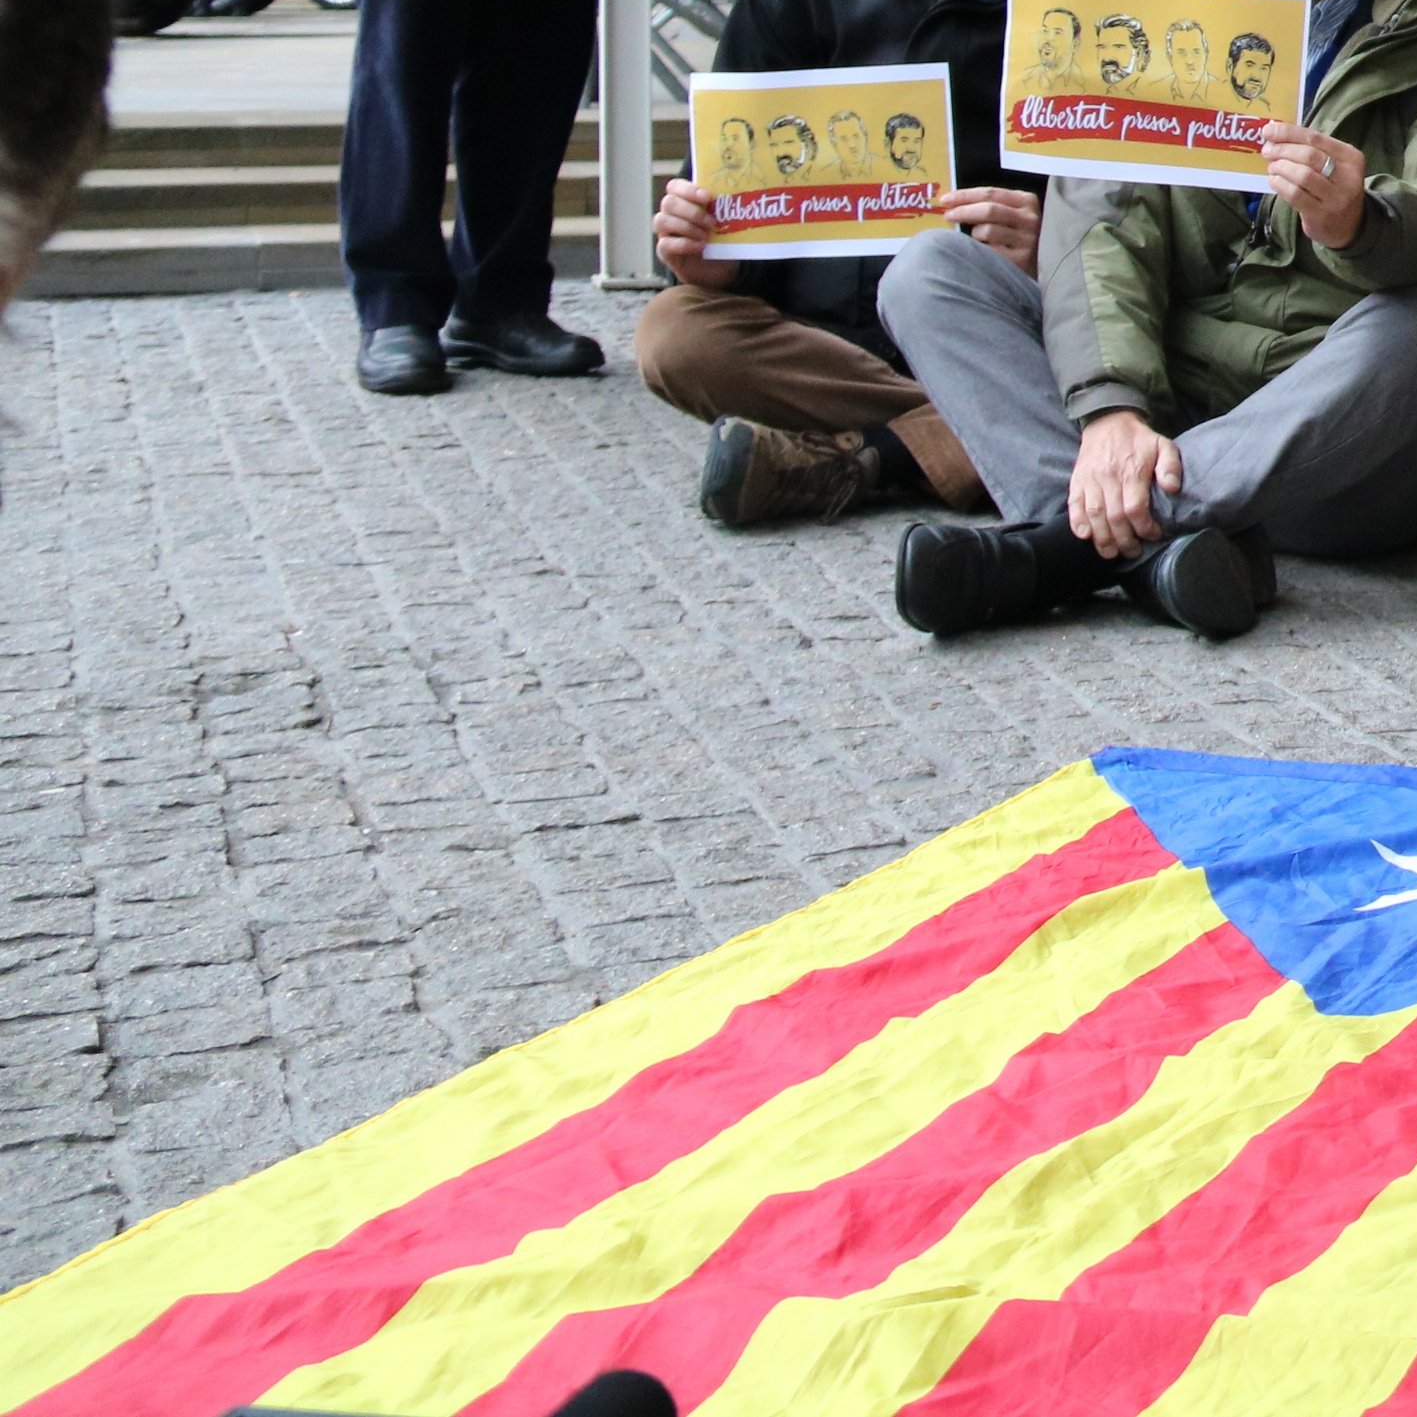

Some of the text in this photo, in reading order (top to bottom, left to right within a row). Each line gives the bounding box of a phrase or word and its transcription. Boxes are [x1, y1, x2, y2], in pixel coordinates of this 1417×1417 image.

[1020, 94, 1116, 130] llibertat
[1120, 111, 1181, 141] presos
[714, 193, 793, 222] llibertat
[800, 195, 852, 223] presos
